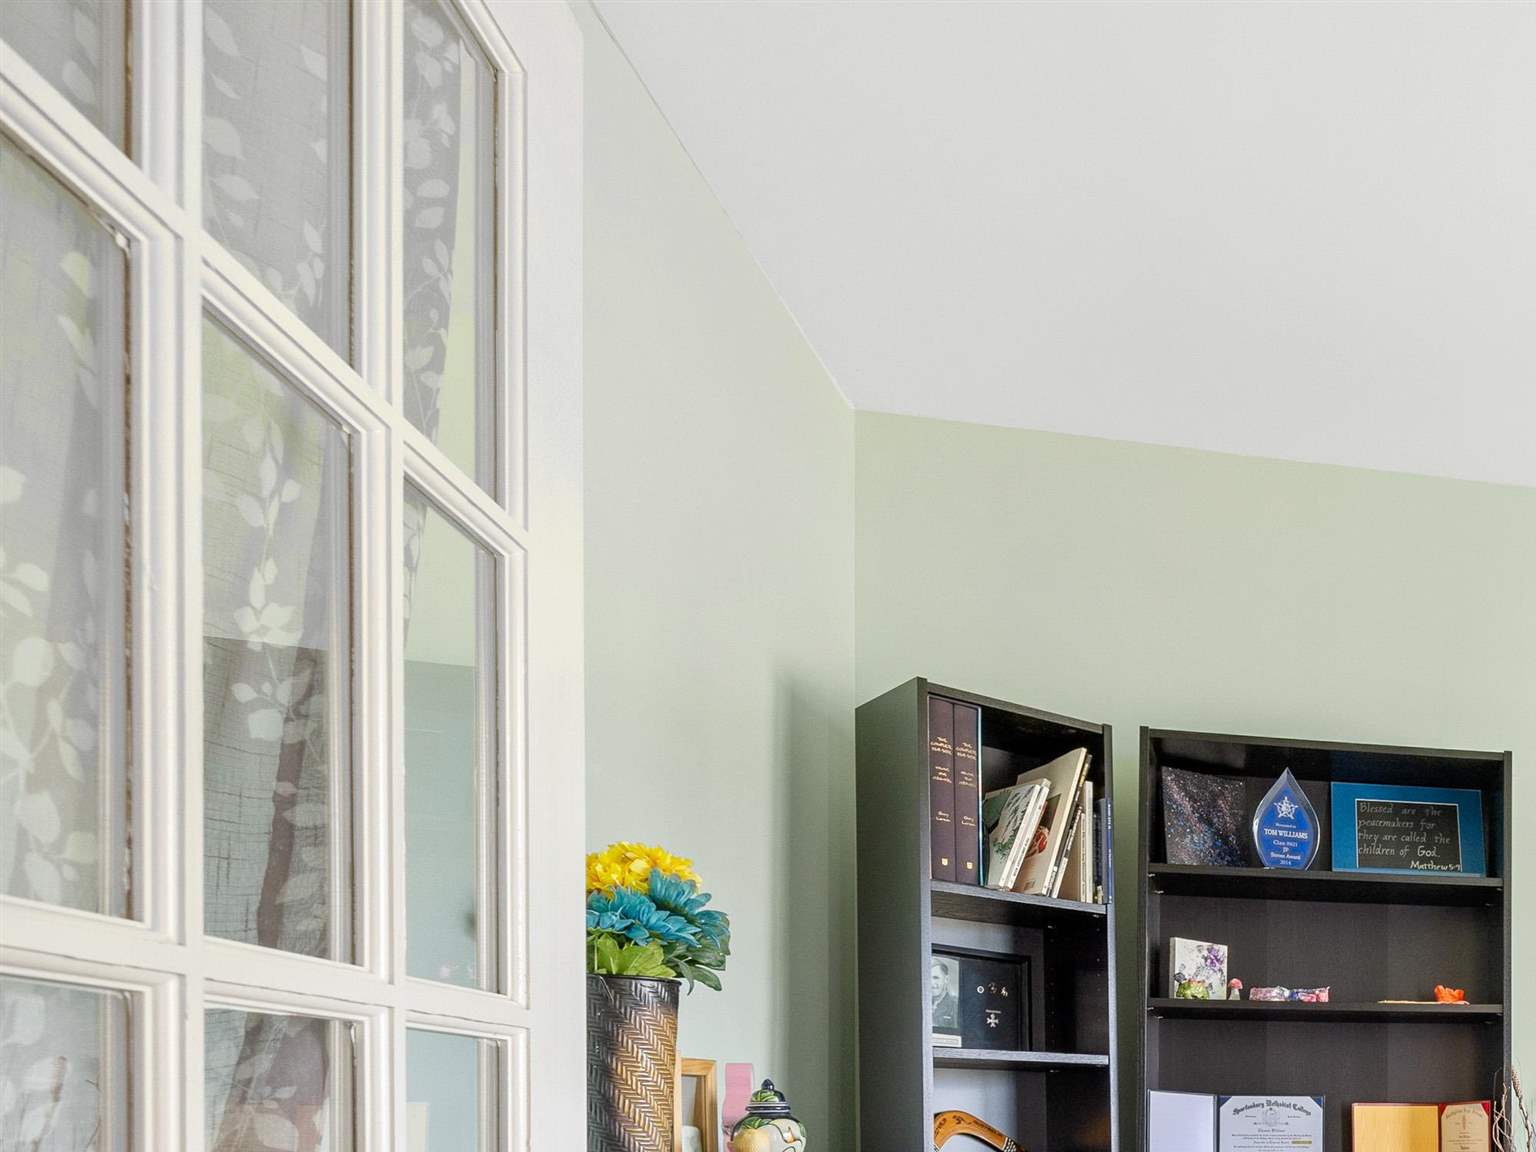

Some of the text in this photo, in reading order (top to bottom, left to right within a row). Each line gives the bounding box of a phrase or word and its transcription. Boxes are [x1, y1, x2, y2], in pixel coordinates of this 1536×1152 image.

[1360, 802, 1393, 813] Blessed
[1425, 807, 1441, 816] the
[1358, 817, 1436, 831] peacemakers for
[1278, 830, 1308, 839] WILLIAMS
[1359, 830, 1379, 843] they
[1401, 832, 1427, 842] called
[1434, 834, 1451, 844] the
[1359, 843, 1395, 855] children
[1399, 847, 1410, 857] of
[1410, 861, 1449, 871] Matthew
